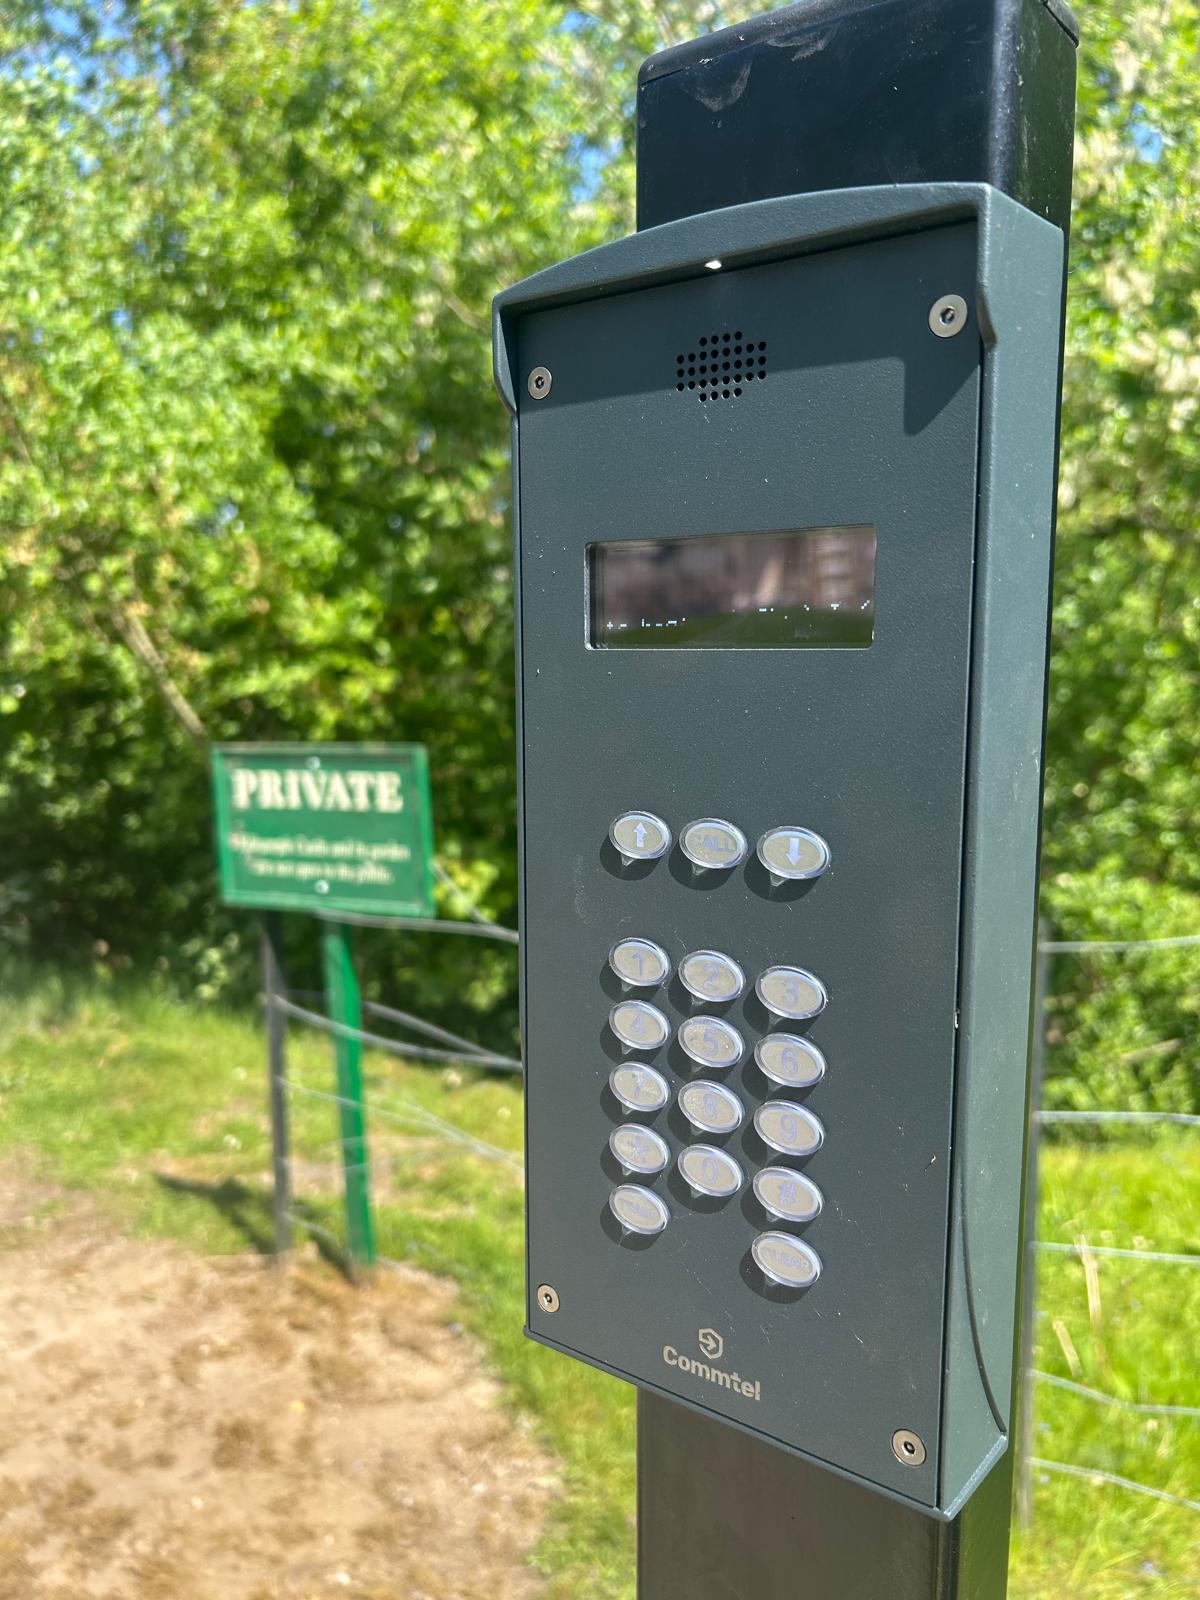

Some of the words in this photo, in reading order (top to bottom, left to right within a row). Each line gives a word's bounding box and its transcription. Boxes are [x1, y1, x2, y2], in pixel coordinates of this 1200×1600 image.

[230, 768, 404, 814] PRIVATE
[632, 950, 644, 976] 1
[703, 963, 719, 990] 2
[782, 976, 798, 1007] 3
[630, 1013, 644, 1038] 4
[703, 1029, 718, 1057] 5
[781, 1047, 798, 1076] 6
[703, 1094, 718, 1121] 8
[780, 1114, 797, 1144] 9
[703, 1158, 718, 1185] 0
[663, 1345, 761, 1401] Commtel
